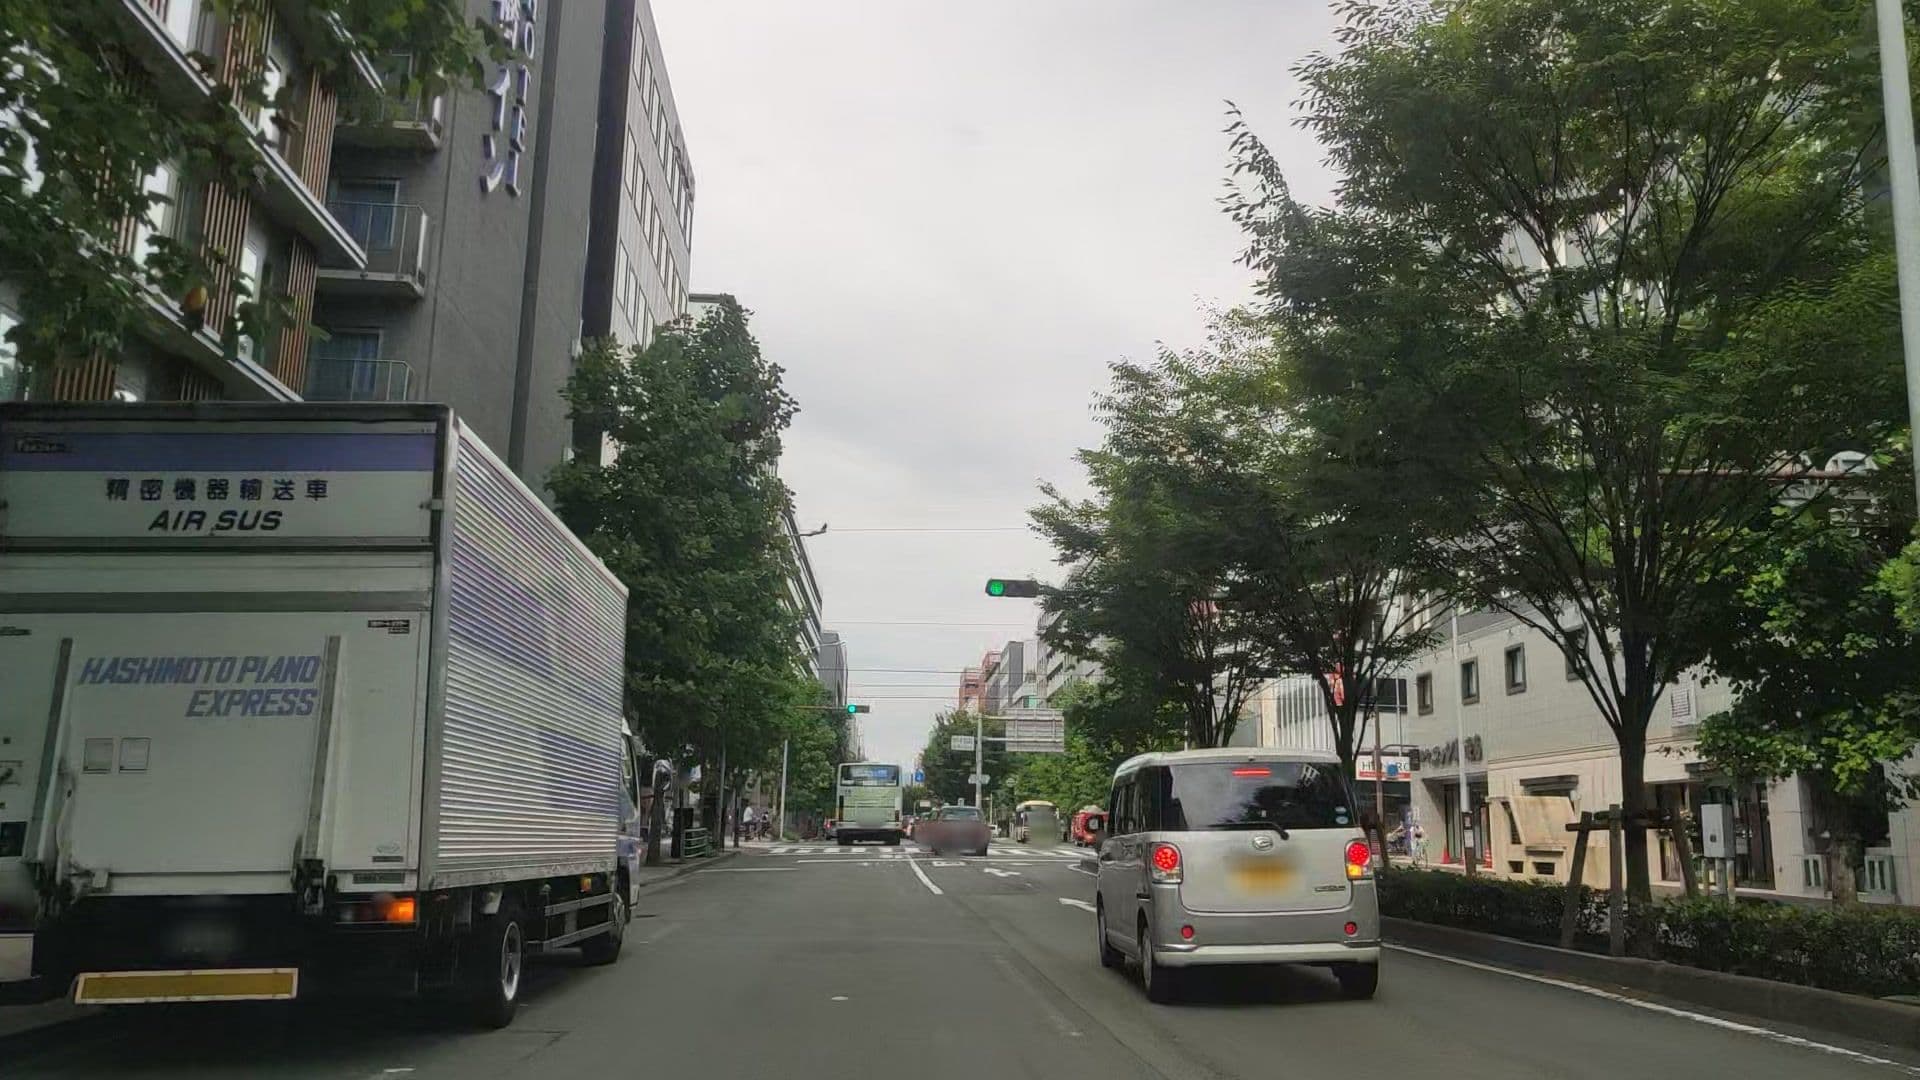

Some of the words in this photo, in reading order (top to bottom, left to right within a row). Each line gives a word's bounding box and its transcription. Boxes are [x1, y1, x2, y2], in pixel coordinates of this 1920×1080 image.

[106, 478, 328, 501] 精密機器輸送車
[148, 509, 207, 531] AIR
[213, 509, 283, 531] SUS
[78, 656, 235, 685] HASHIMOTO
[237, 655, 321, 684] PIANO
[185, 688, 319, 717] EXPRESS
